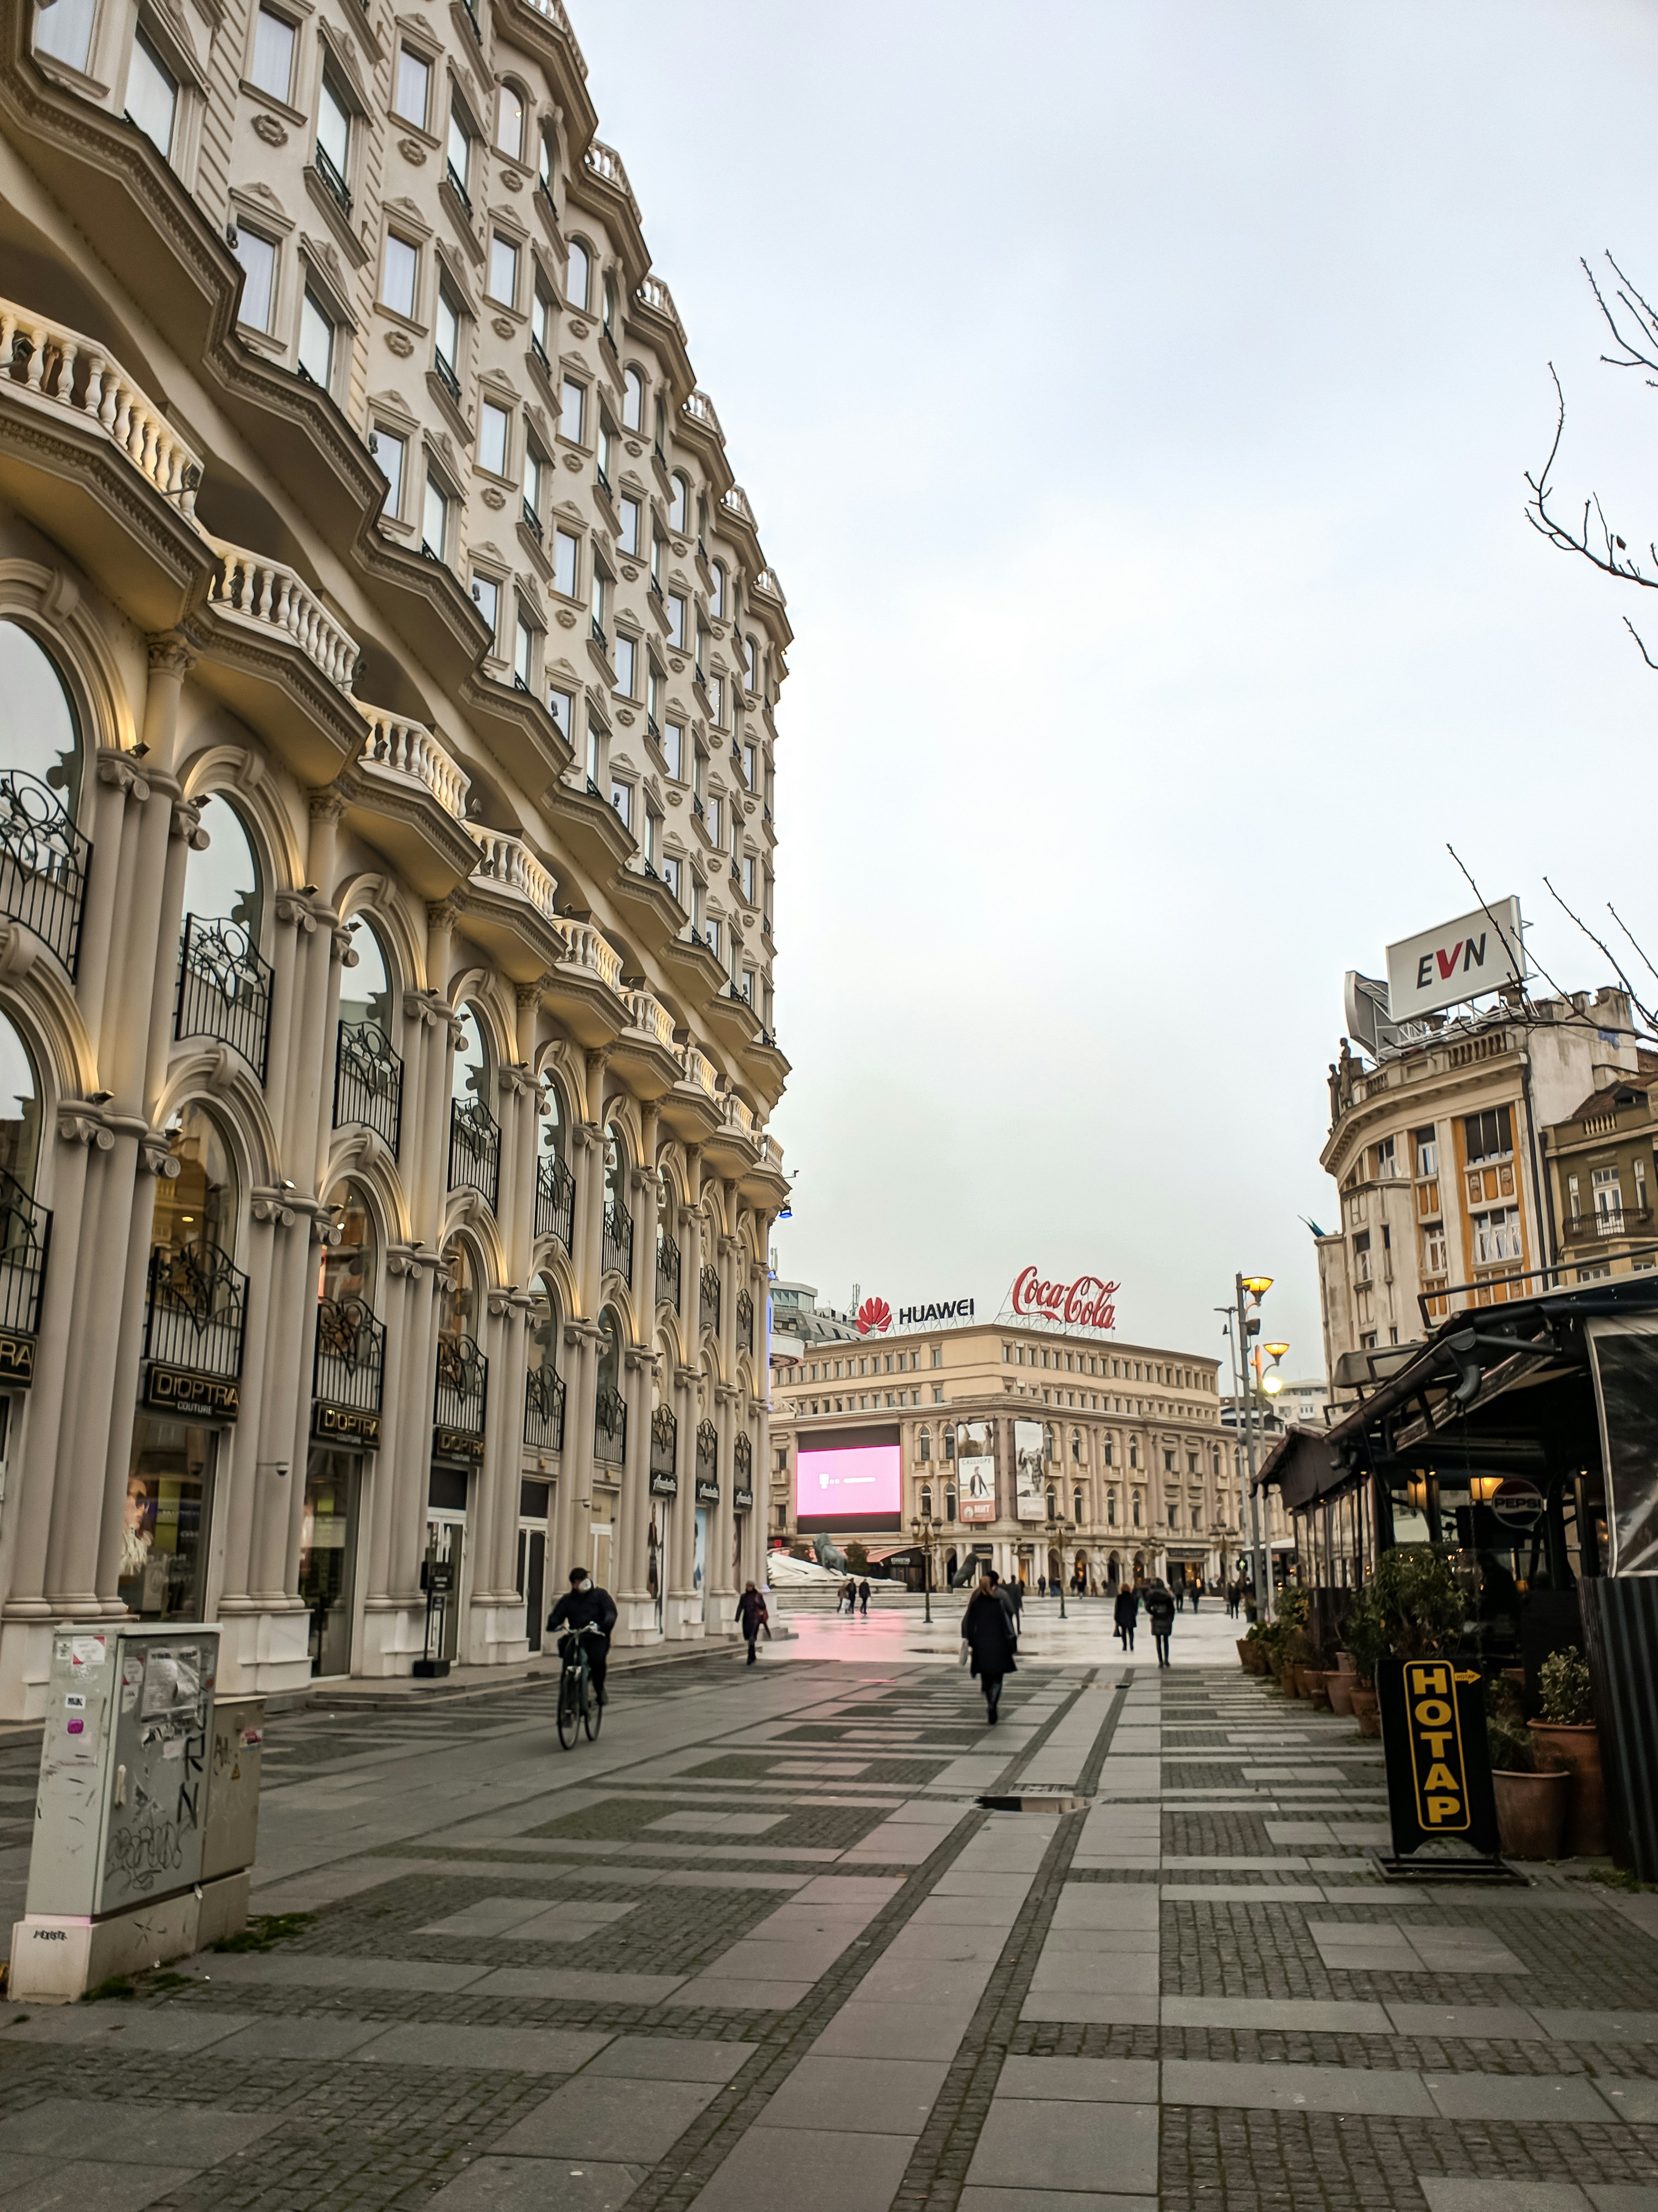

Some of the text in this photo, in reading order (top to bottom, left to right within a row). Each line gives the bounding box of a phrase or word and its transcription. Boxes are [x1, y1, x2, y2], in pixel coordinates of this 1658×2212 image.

[1417, 932, 1486, 989] EVN
[899, 1298, 974, 1324] HUAWEI
[1012, 1265, 1121, 1329] Coca-Cola
[157, 1374, 239, 1406] DIOPTRA
[177, 1400, 212, 1415] COUTURE
[1495, 1498, 1541, 1509] PEPSI
